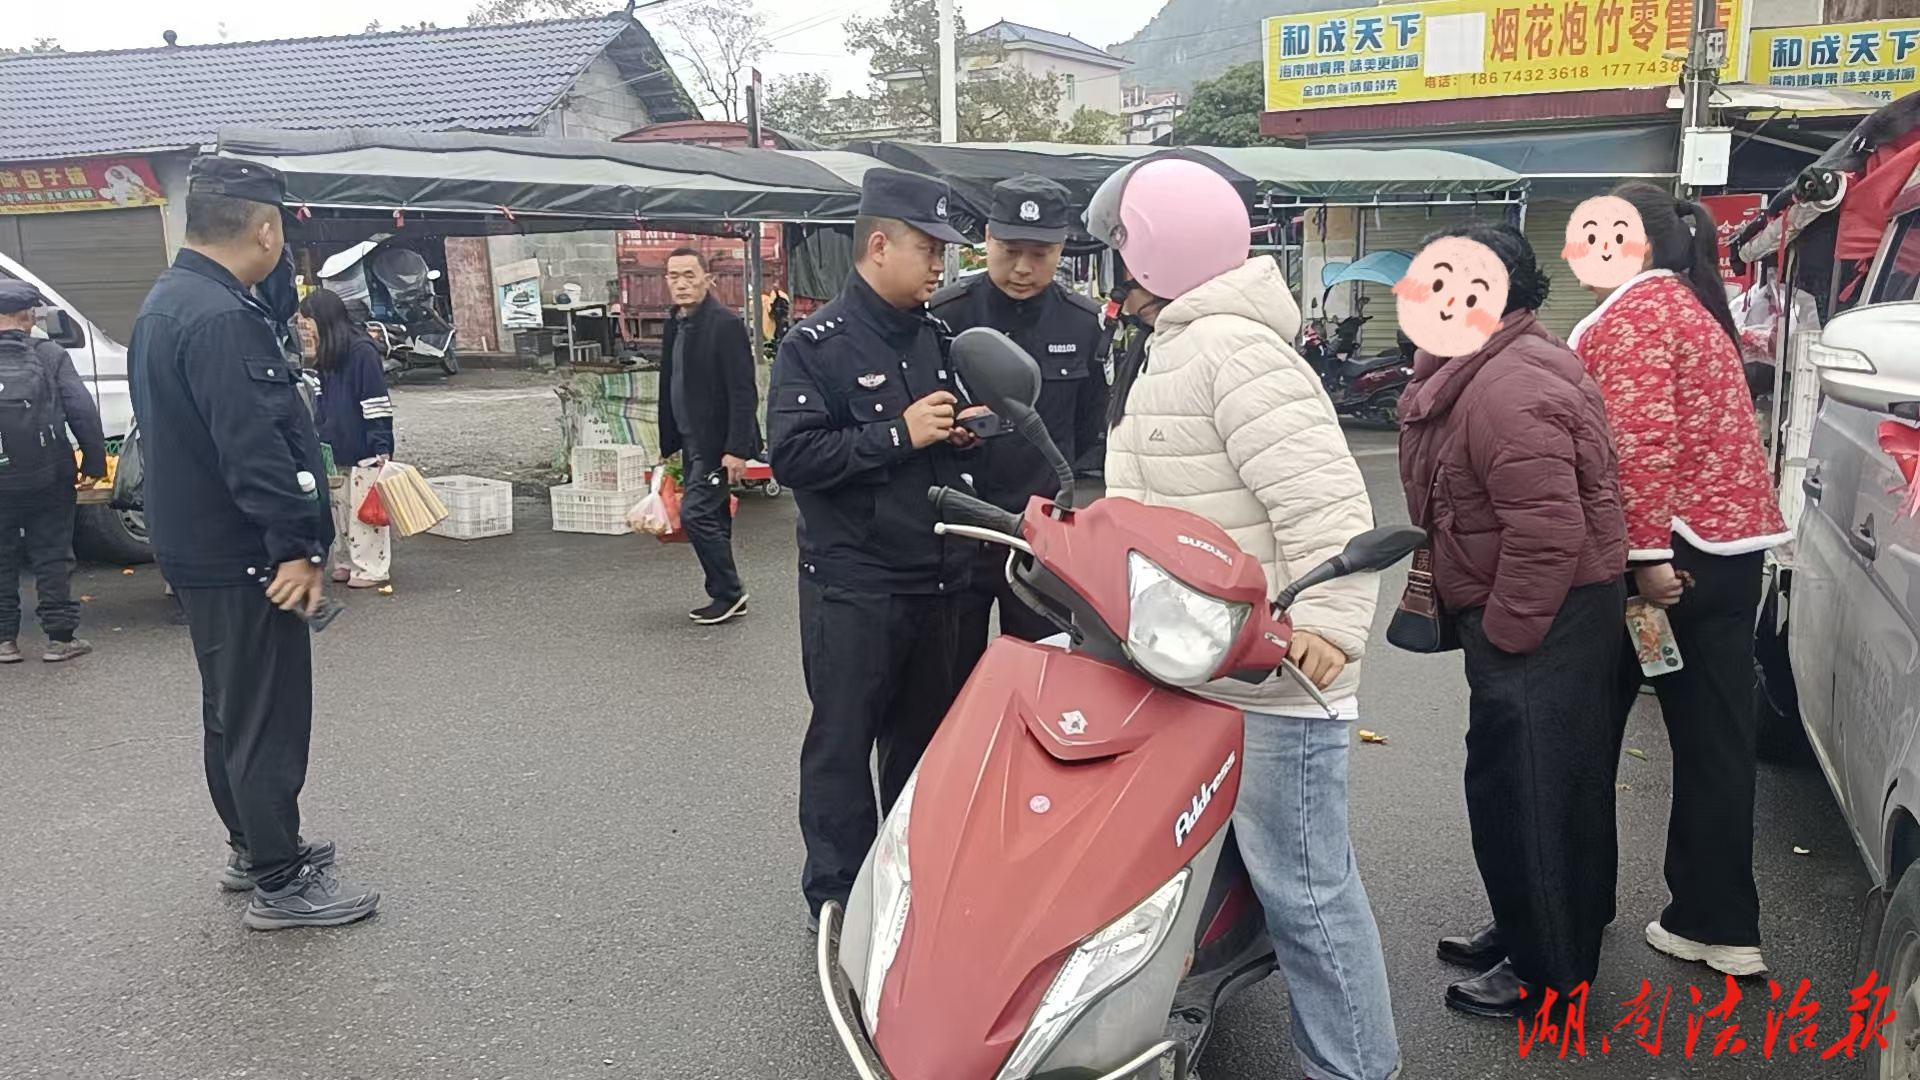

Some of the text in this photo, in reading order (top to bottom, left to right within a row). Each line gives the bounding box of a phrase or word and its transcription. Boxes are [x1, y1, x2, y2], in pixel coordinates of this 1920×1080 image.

[1282, 13, 1421, 57] 和成天下
[1772, 29, 1920, 67] 和成天下
[1424, 75, 1457, 88] 电话：
[1470, 73, 1498, 86] 186
[1503, 69, 1544, 83] 7432
[1549, 66, 1589, 80] 3618
[1601, 63, 1631, 77] 177
[1177, 535, 1233, 566] SUZUKI
[1174, 750, 1236, 847] Address
